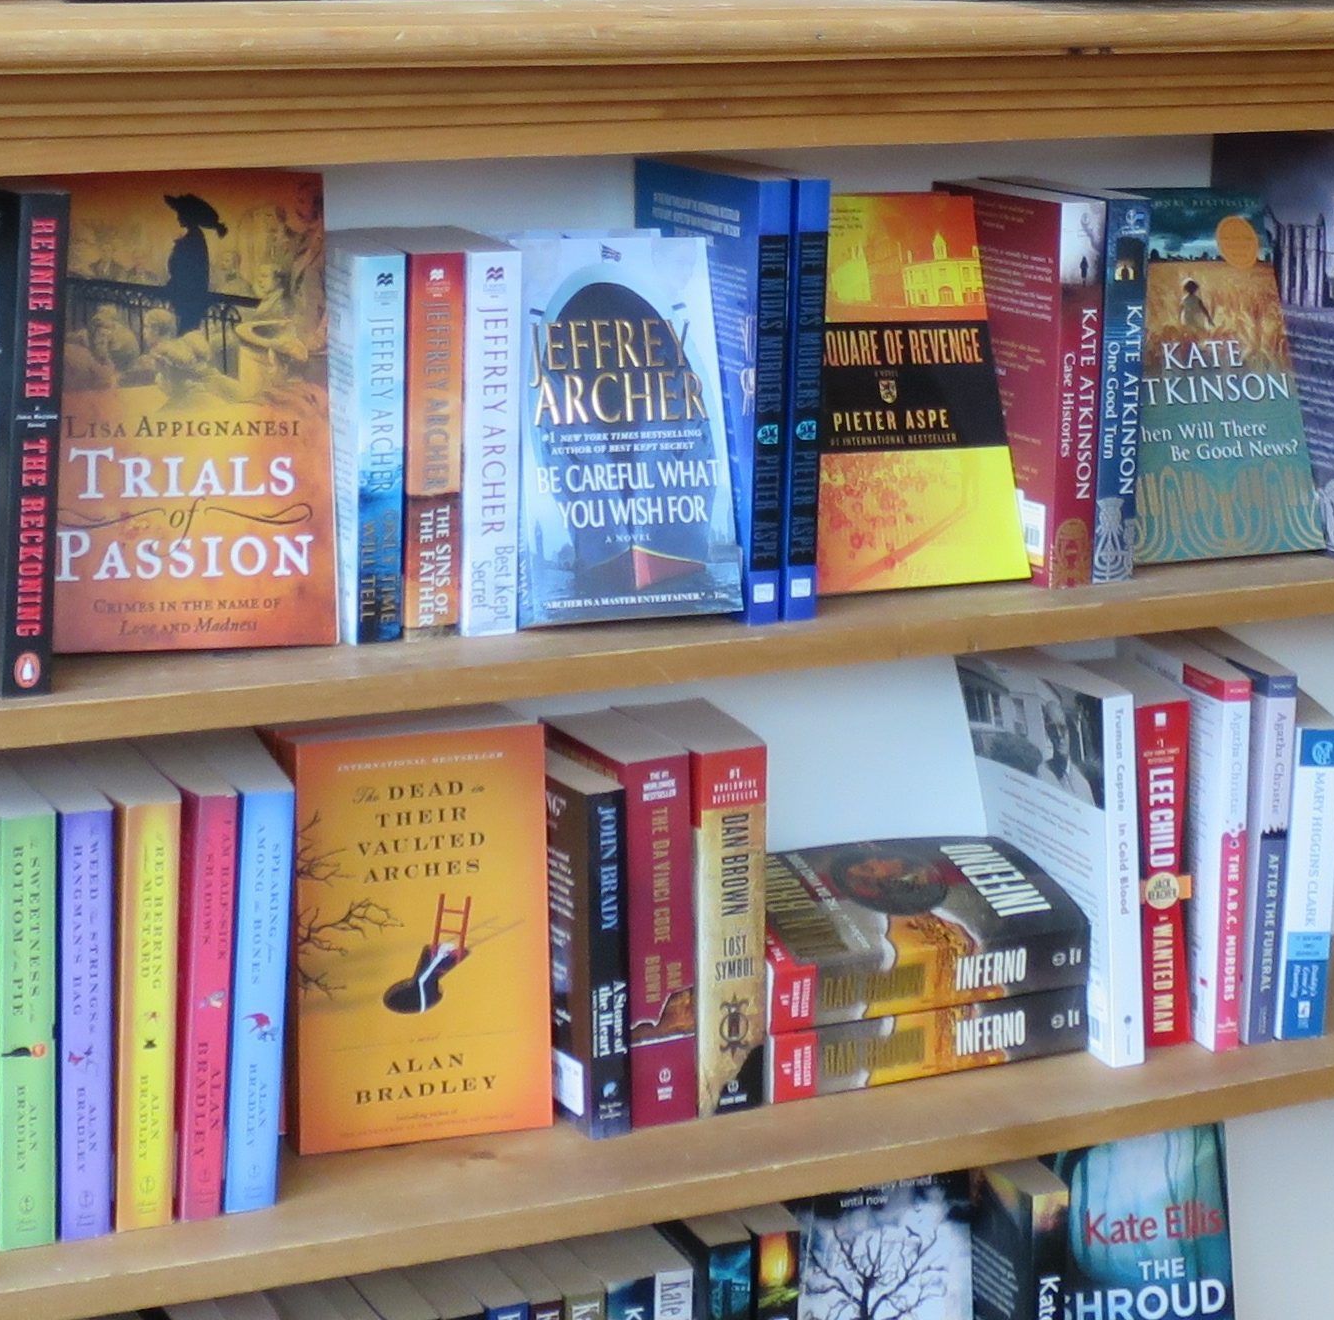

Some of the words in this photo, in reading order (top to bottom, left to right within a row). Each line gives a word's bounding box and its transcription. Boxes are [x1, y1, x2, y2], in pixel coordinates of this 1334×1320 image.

[30, 218, 58, 311] RENNIE
[25, 321, 53, 398] AIRTH
[529, 319, 690, 387] JEFFREY
[884, 329, 904, 364] OF
[910, 327, 983, 364] REVENGE
[1163, 340, 1243, 369] KATE
[535, 373, 709, 425] ARCHER
[1142, 373, 1291, 407] TKINSON
[833, 410, 896, 432] PIETER
[906, 409, 950, 429] ASPE
[1178, 424, 1214, 441] Will
[1223, 422, 1266, 438] There
[22, 438, 49, 487] THE
[1171, 444, 1191, 461] Be
[1196, 443, 1242, 459] Good
[1250, 439, 1298, 456] News?
[69, 448, 296, 498] TRIALS
[537, 467, 562, 494] BE
[566, 464, 656, 492] CAREFUL
[661, 459, 720, 488] WHAT
[170, 497, 206, 557] of
[558, 501, 608, 528] YOU
[612, 499, 664, 526] WISH
[668, 494, 708, 523] FOR
[15, 497, 46, 638] RECKONING
[55, 532, 315, 582] PASSION
[388, 781, 465, 800] DEAD
[1147, 766, 1175, 807] LEE
[375, 806, 467, 828] THEIR
[598, 806, 617, 857] JOHN
[721, 812, 749, 851] DAN
[356, 832, 486, 857] VAULTED
[1147, 812, 1173, 870] CHILD
[362, 858, 480, 883] ARCHES
[721, 857, 749, 917] BROWN
[600, 859, 618, 931] BRADY
[955, 949, 1026, 991] INFERNO
[1152, 923, 1174, 987] WANTED
[1152, 990, 1173, 1033] MAN
[955, 1010, 1026, 1056] INFERNO
[387, 1053, 465, 1075] ALAN
[355, 1075, 498, 1106] BRADLEY
[1083, 1211, 1158, 1245] Kate
[1165, 1205, 1222, 1236] Ellis
[1137, 1258, 1185, 1282] THE
[1065, 1279, 1226, 1320] HROUD
